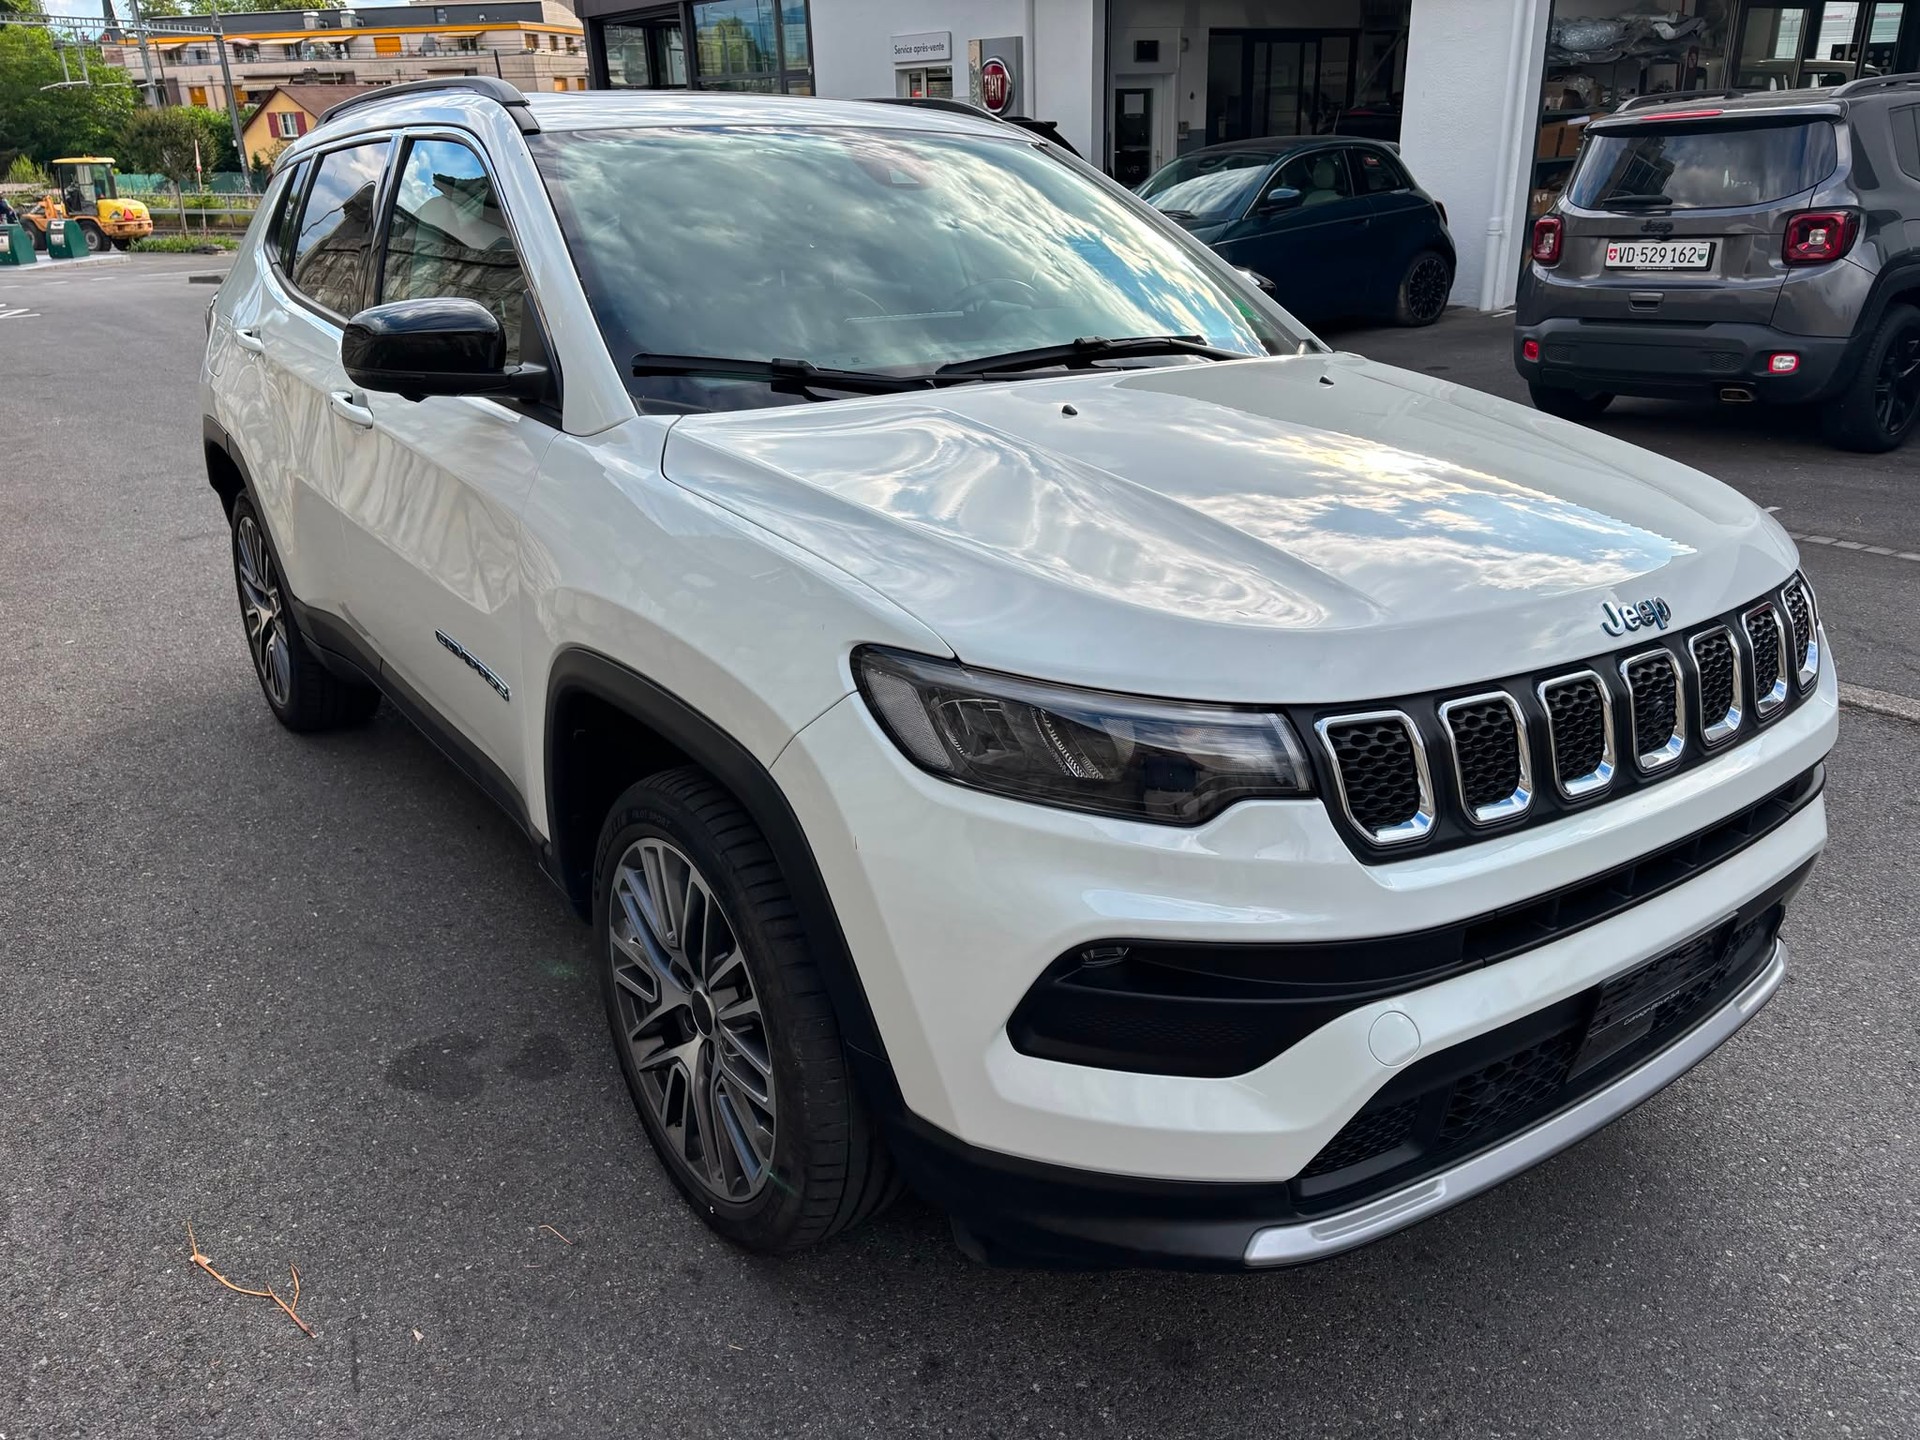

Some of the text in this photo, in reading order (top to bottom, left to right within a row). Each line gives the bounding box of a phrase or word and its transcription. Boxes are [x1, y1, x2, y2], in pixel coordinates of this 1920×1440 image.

[894, 42, 945, 56] Service après-vente
[984, 73, 1002, 101] FIAT
[1641, 219, 1674, 234] Jeep
[1602, 596, 1672, 637] Jeep
